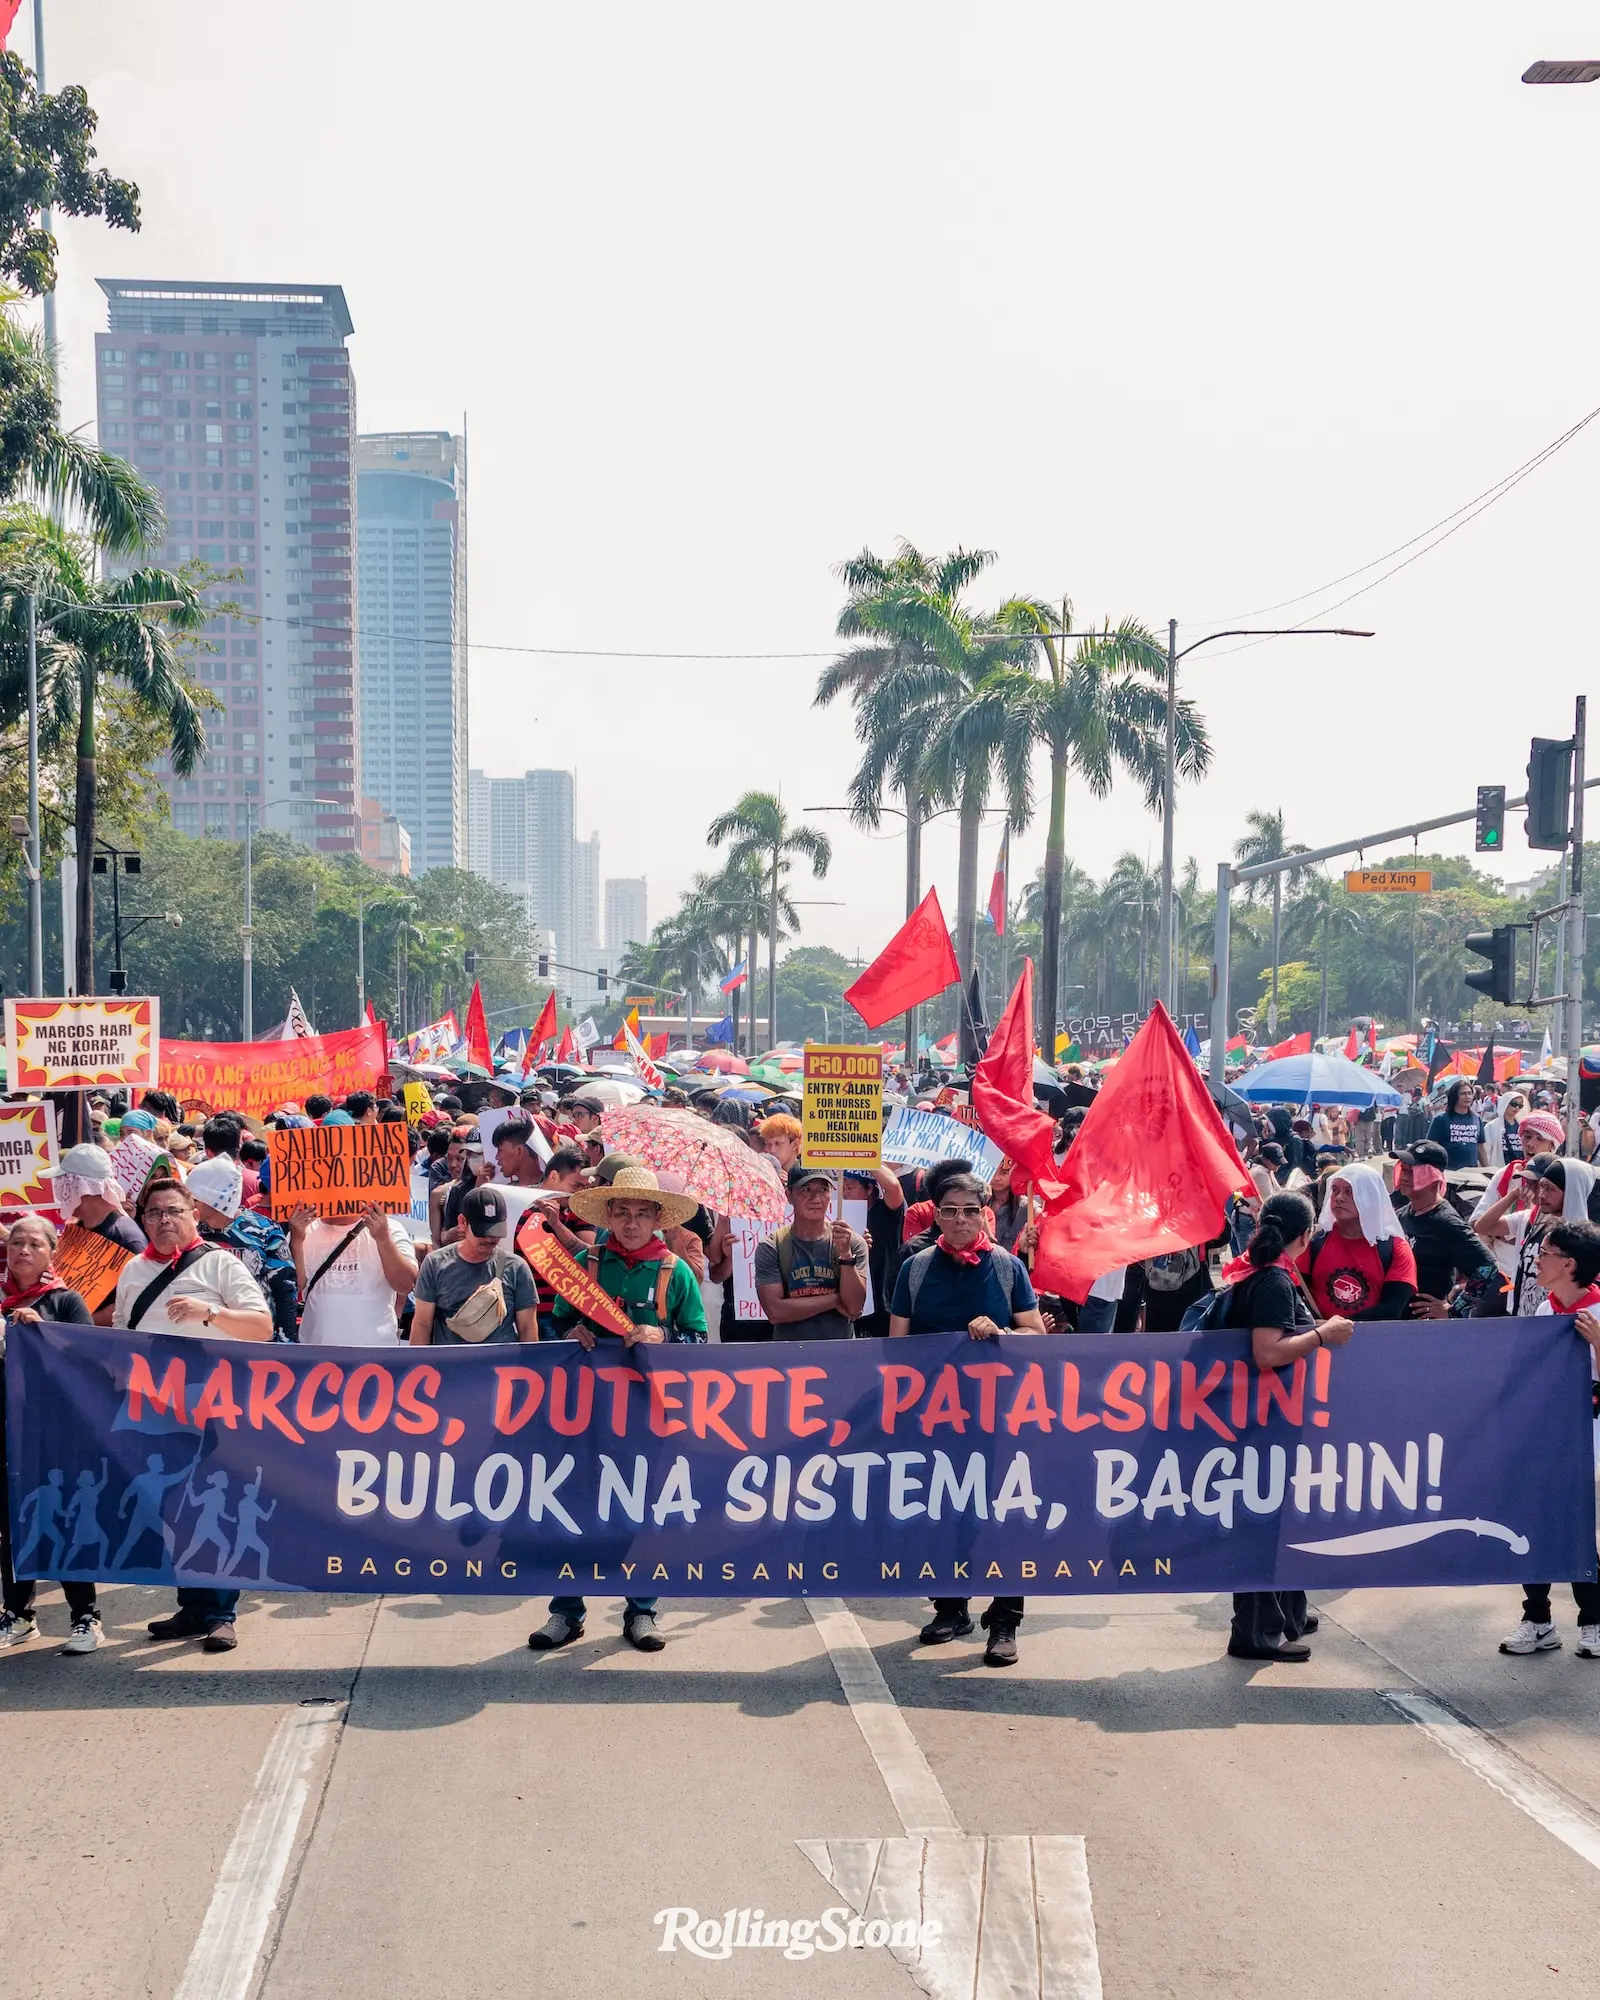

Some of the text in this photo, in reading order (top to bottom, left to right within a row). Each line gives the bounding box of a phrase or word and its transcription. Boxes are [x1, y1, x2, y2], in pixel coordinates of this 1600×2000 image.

[1362, 872, 1416, 887] Ped Xing
[35, 1024, 132, 1039] MARCOS HARI
[48, 1040, 66, 1054] NG
[43, 1053, 125, 1067] PANAGUTIN!
[212, 1065, 246, 1085] ANG
[334, 1048, 356, 1070] NG
[809, 1055, 878, 1077] P50,000
[807, 1081, 880, 1096] ENTRY SALARY
[816, 1097, 871, 1109] FOR NURSES
[809, 1110, 877, 1120] & OTHER ALLIED
[827, 1121, 859, 1131] HEALTH
[352, 1124, 405, 1157] ITAAS
[807, 1132, 878, 1143] PROFESSIONALS
[882, 1129, 911, 1146] YAN
[912, 1131, 941, 1153] MGA
[964, 1129, 987, 1157] NA
[0, 1140, 33, 1156] MGA
[353, 1156, 408, 1188] IBABA
[791, 1265, 811, 1281] LUCKY
[813, 1265, 835, 1280] BRAND
[129, 1347, 1332, 1451] MARCOS, DUTERTE, PATALSIKIN!
[336, 1433, 1444, 1536] BULOK NA SISTEMA, BAGUHIN!
[327, 1556, 1173, 1581] BAGONG ALYANSANG MAKABAYAN
